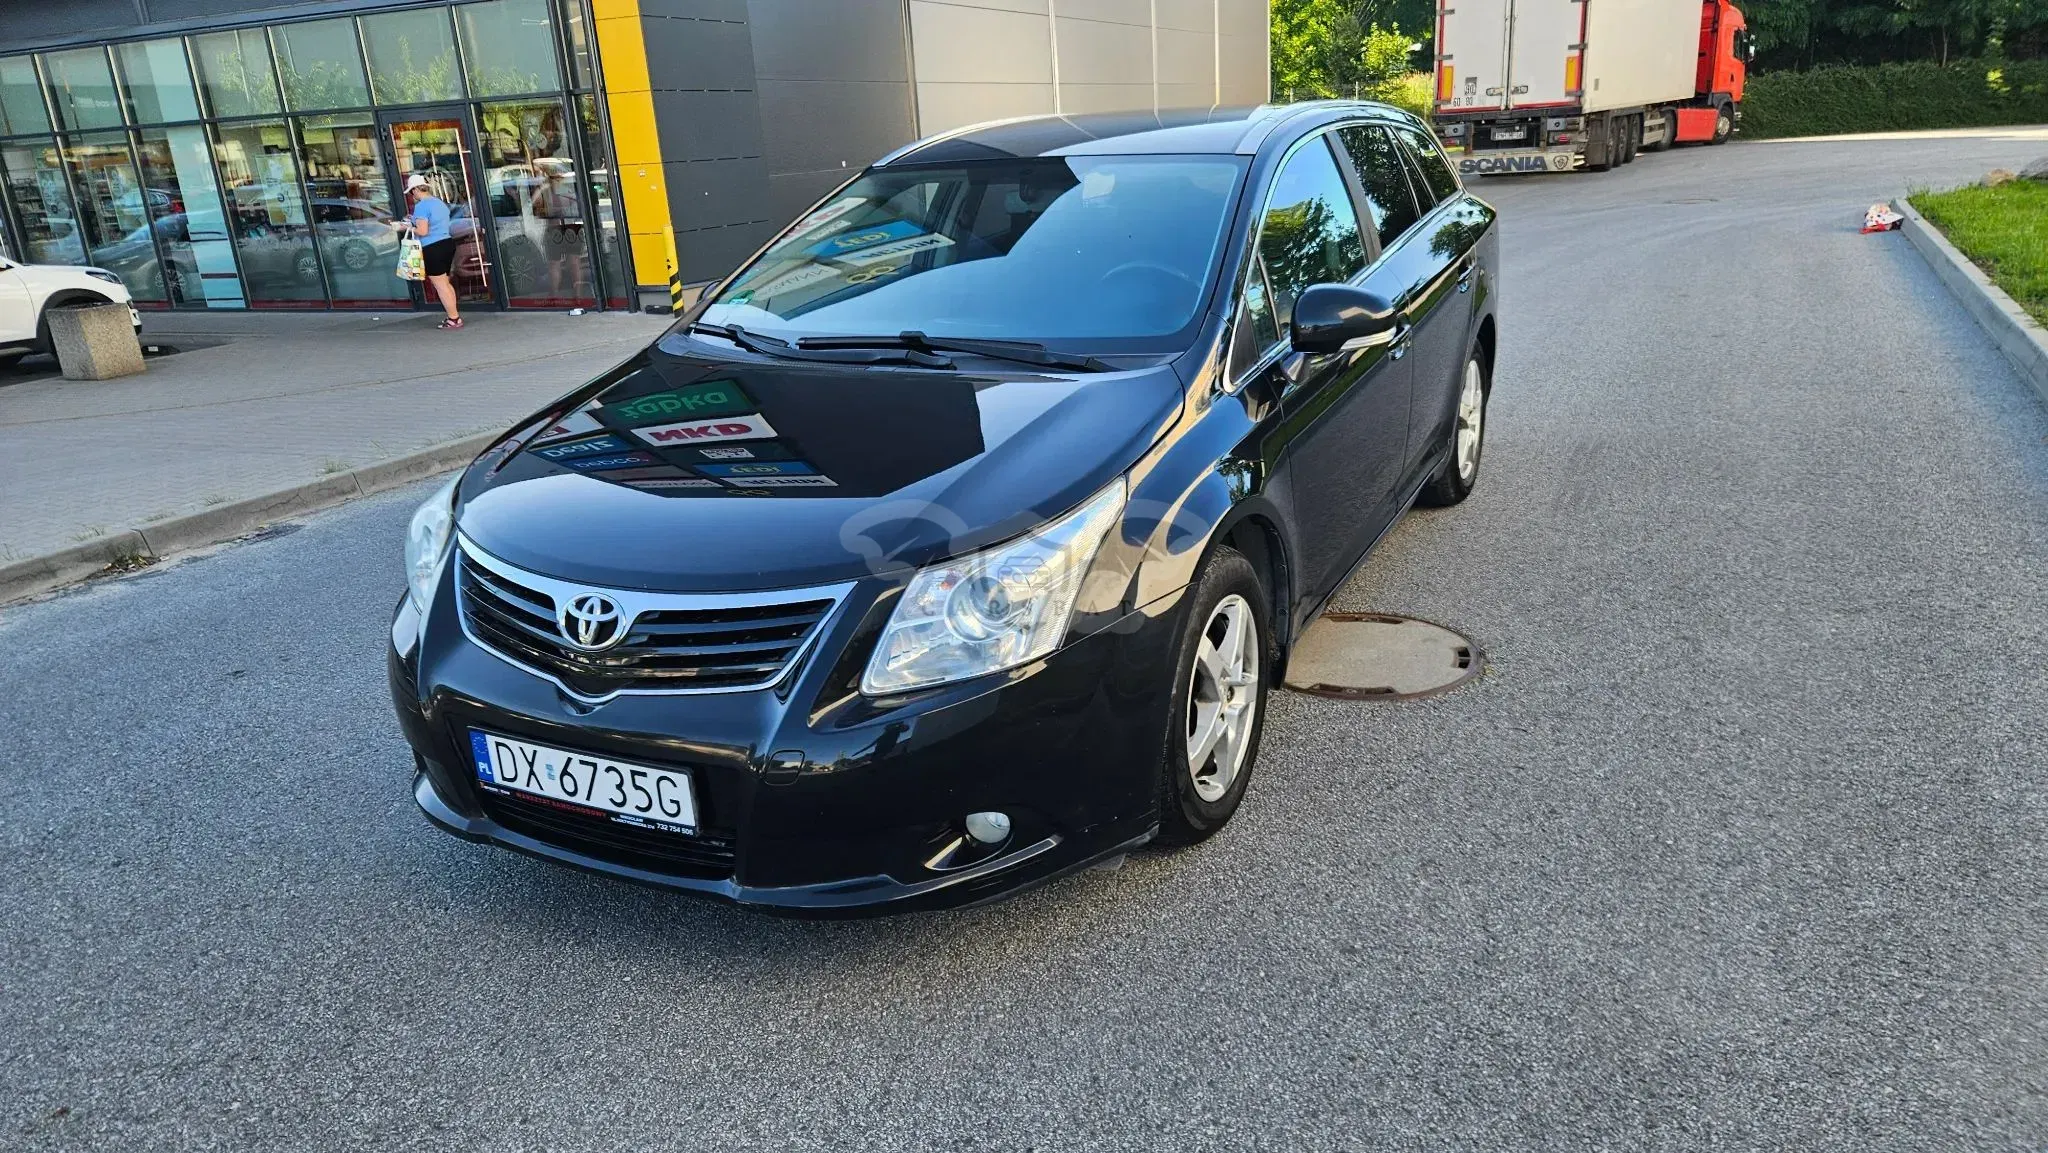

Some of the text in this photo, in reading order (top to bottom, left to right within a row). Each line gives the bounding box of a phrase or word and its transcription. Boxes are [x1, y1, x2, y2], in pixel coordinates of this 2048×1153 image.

[1459, 156, 1548, 174] SCANIA
[479, 762, 492, 775] PL
[495, 741, 681, 818] DX 6735G
